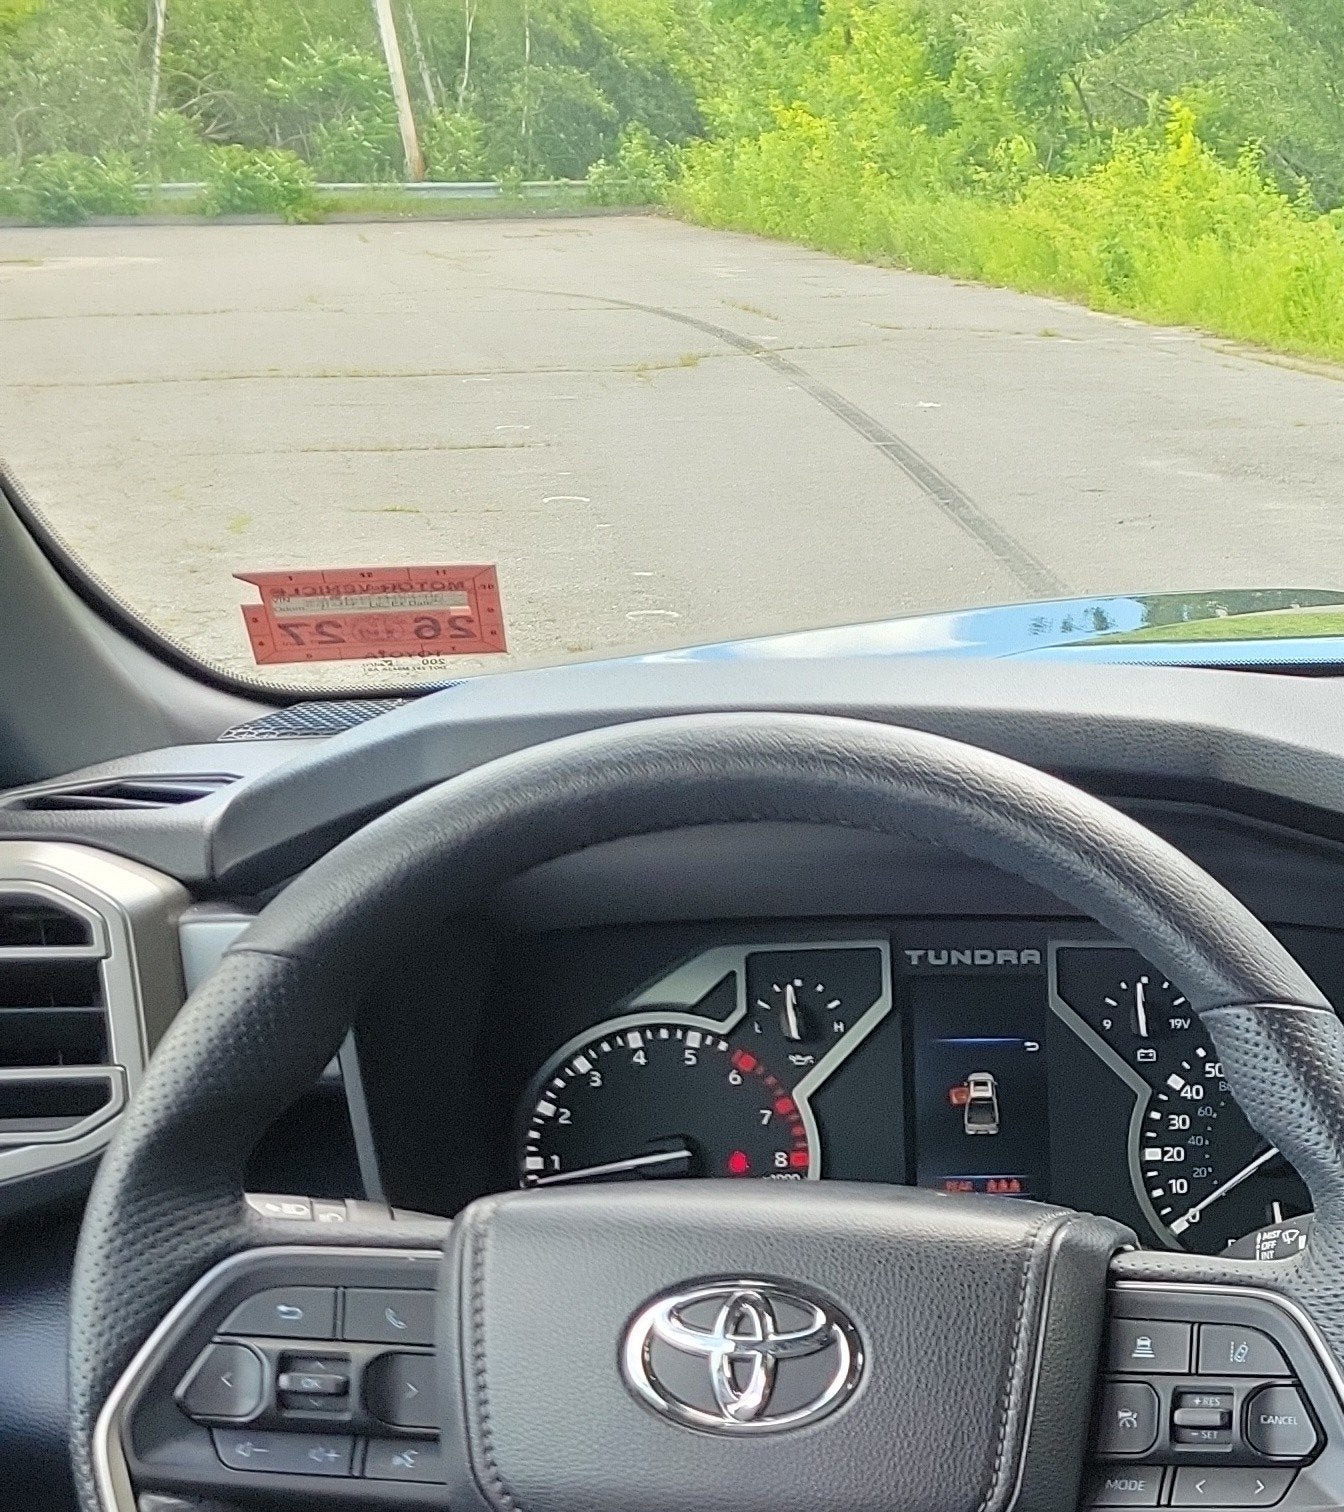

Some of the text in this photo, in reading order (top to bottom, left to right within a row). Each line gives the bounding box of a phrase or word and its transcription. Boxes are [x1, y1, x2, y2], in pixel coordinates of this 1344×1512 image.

[904, 948, 1041, 966] TUNDRA
[1103, 1019, 1112, 1030] 9
[1169, 1018, 1191, 1029] 19V
[632, 1050, 647, 1066] 4
[685, 1050, 697, 1066] 5
[590, 1072, 603, 1088] 3
[728, 1070, 742, 1085] 6
[1180, 1085, 1204, 1100] 40
[559, 1109, 571, 1125] 2
[760, 1109, 772, 1125] 7
[1168, 1115, 1190, 1130] 30
[774, 1151, 788, 1167] 8
[1163, 1147, 1185, 1161] 20
[551, 1155, 560, 1170] 1
[1168, 1179, 1188, 1194] 10
[1260, 1414, 1298, 1425] CANCEL
[1105, 1478, 1146, 1492] MODE
